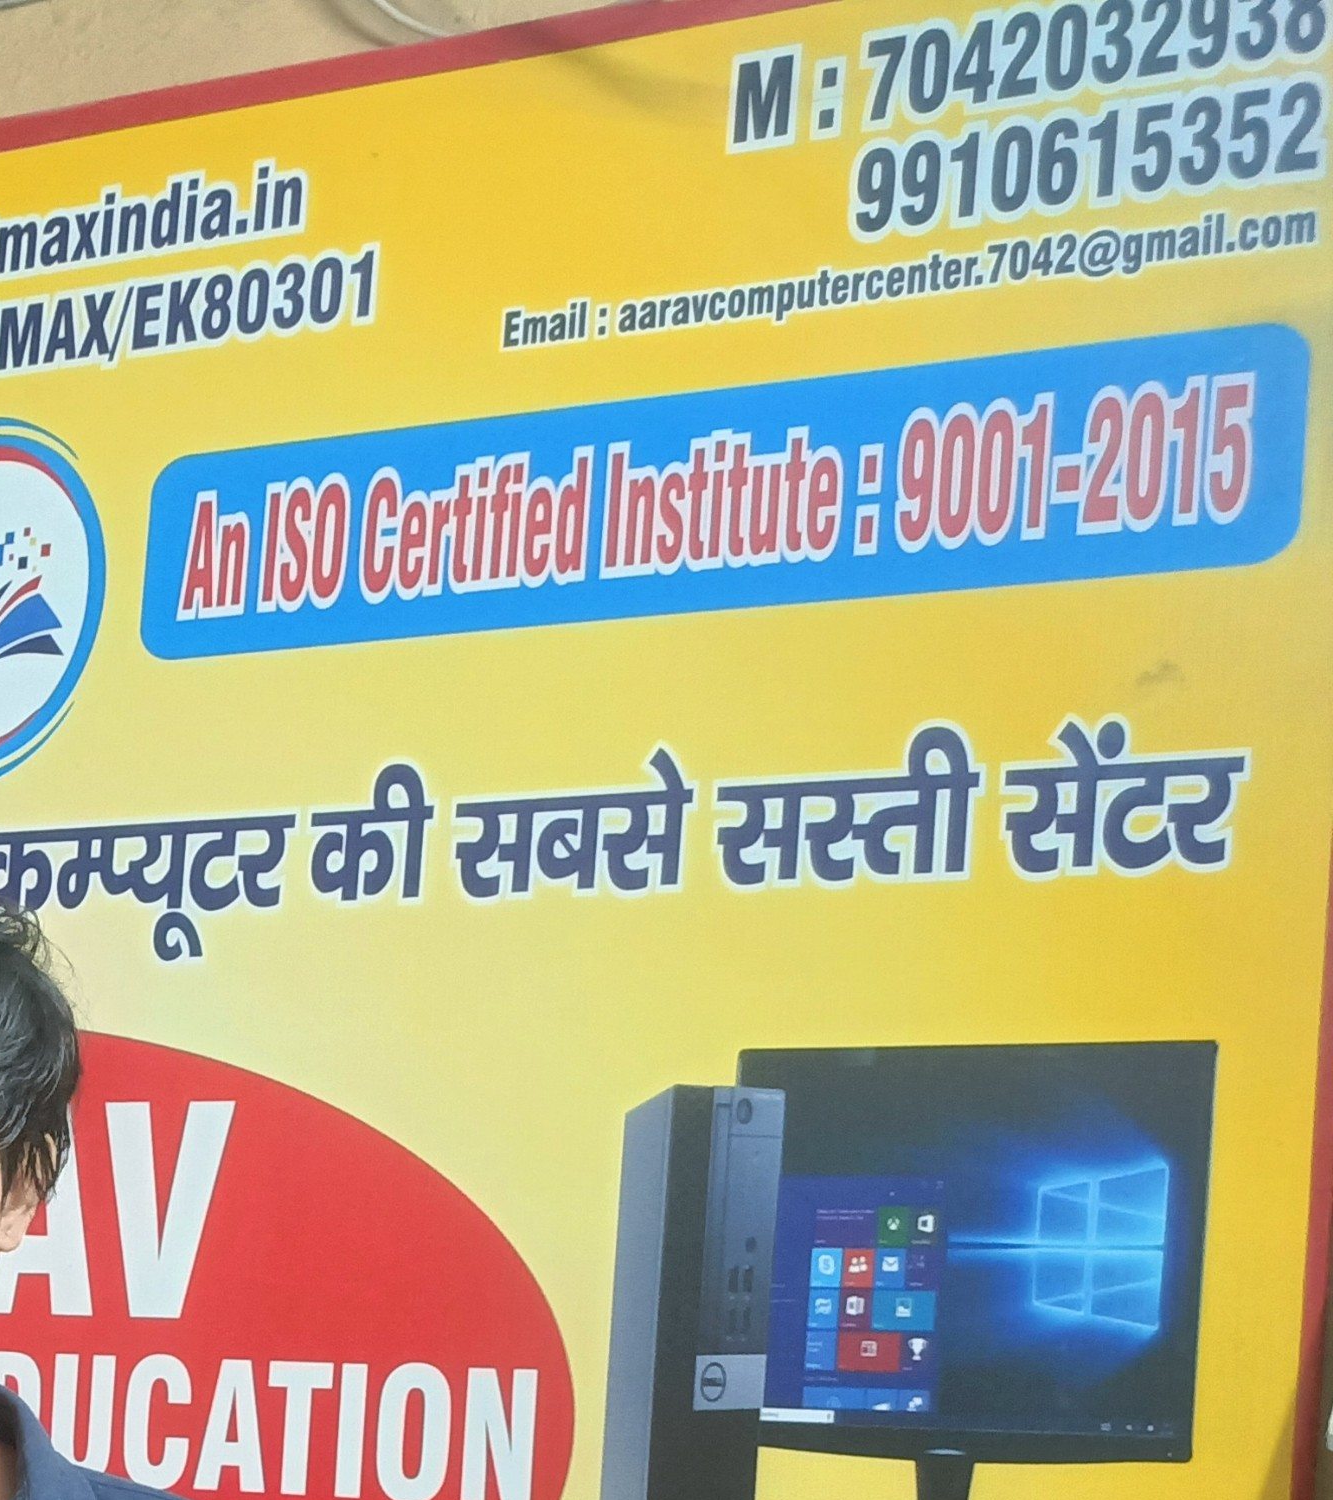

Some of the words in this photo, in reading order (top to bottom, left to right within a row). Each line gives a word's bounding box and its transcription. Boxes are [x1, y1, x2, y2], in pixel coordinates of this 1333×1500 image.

[734, 53, 795, 144] M
[865, 0, 1327, 121] 7042032938
[855, 83, 1321, 232] 9910615352
[503, 303, 587, 348] Email
[618, 211, 1316, 335] aaravcomputercenter.7042@gmail.com
[181, 502, 250, 610] An
[261, 483, 347, 604] ISO
[361, 457, 587, 600] Certified
[605, 436, 839, 570] Institute
[899, 383, 1254, 541] 9001-2015
[311, 764, 432, 900] की
[456, 748, 693, 898] सबसे
[716, 725, 980, 884] सस्ती
[1004, 718, 1246, 874] सेंटर
